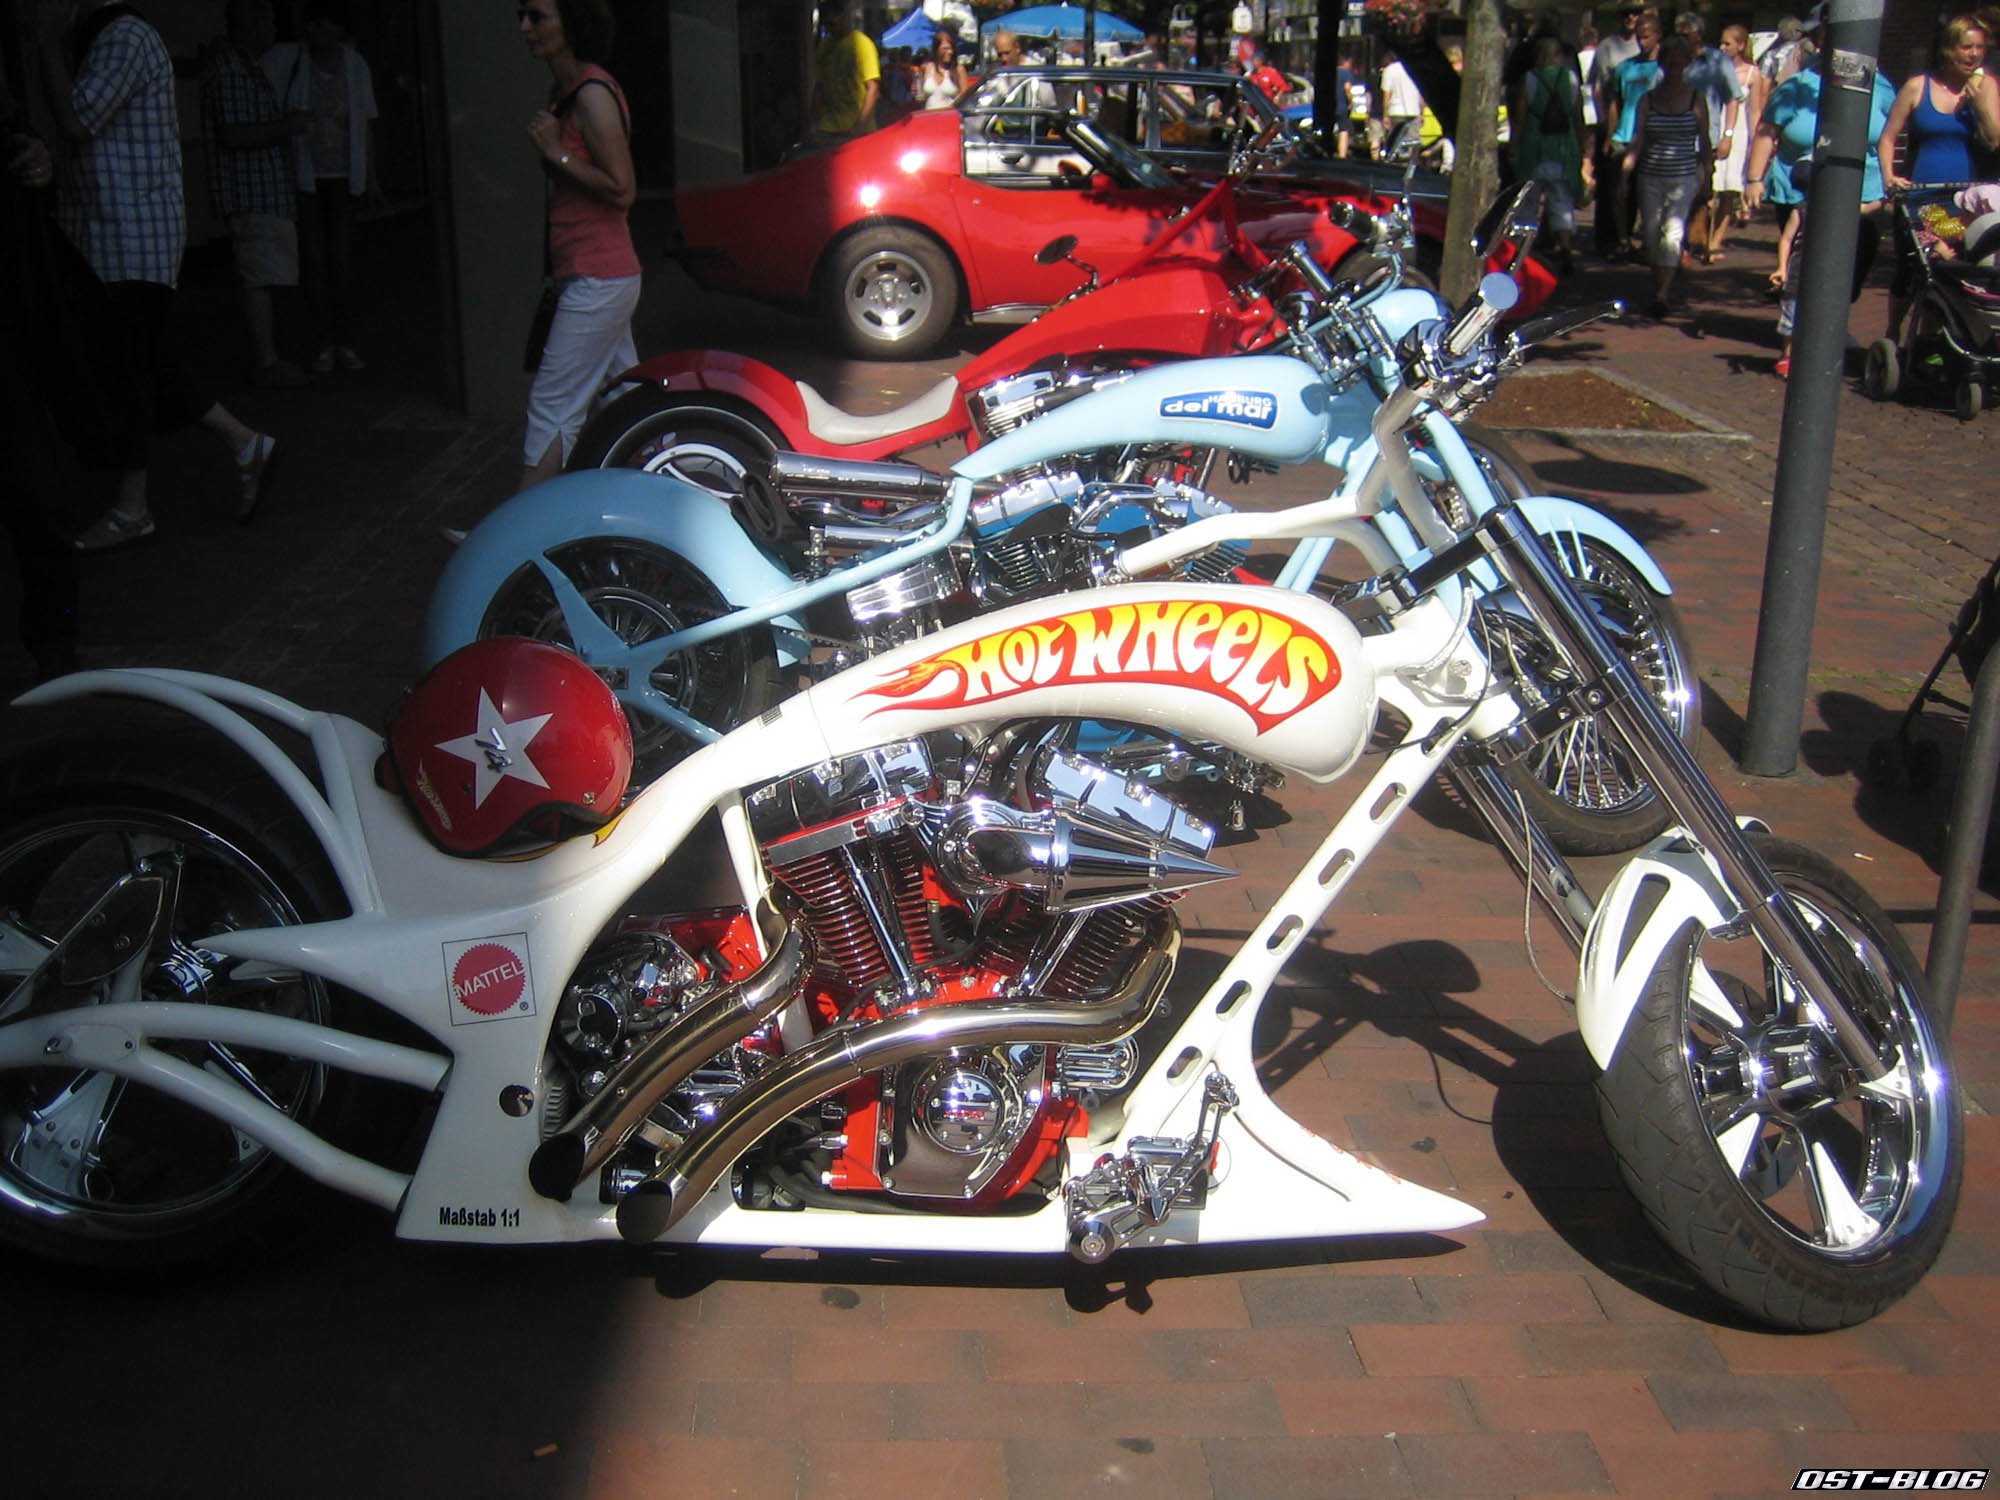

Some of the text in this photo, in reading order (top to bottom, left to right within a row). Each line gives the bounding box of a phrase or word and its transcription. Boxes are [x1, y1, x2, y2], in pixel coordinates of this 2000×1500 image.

[1164, 399, 1273, 419] del mar
[454, 961, 527, 998] MATTEL
[440, 1207, 520, 1227] Maßstab 1:1
